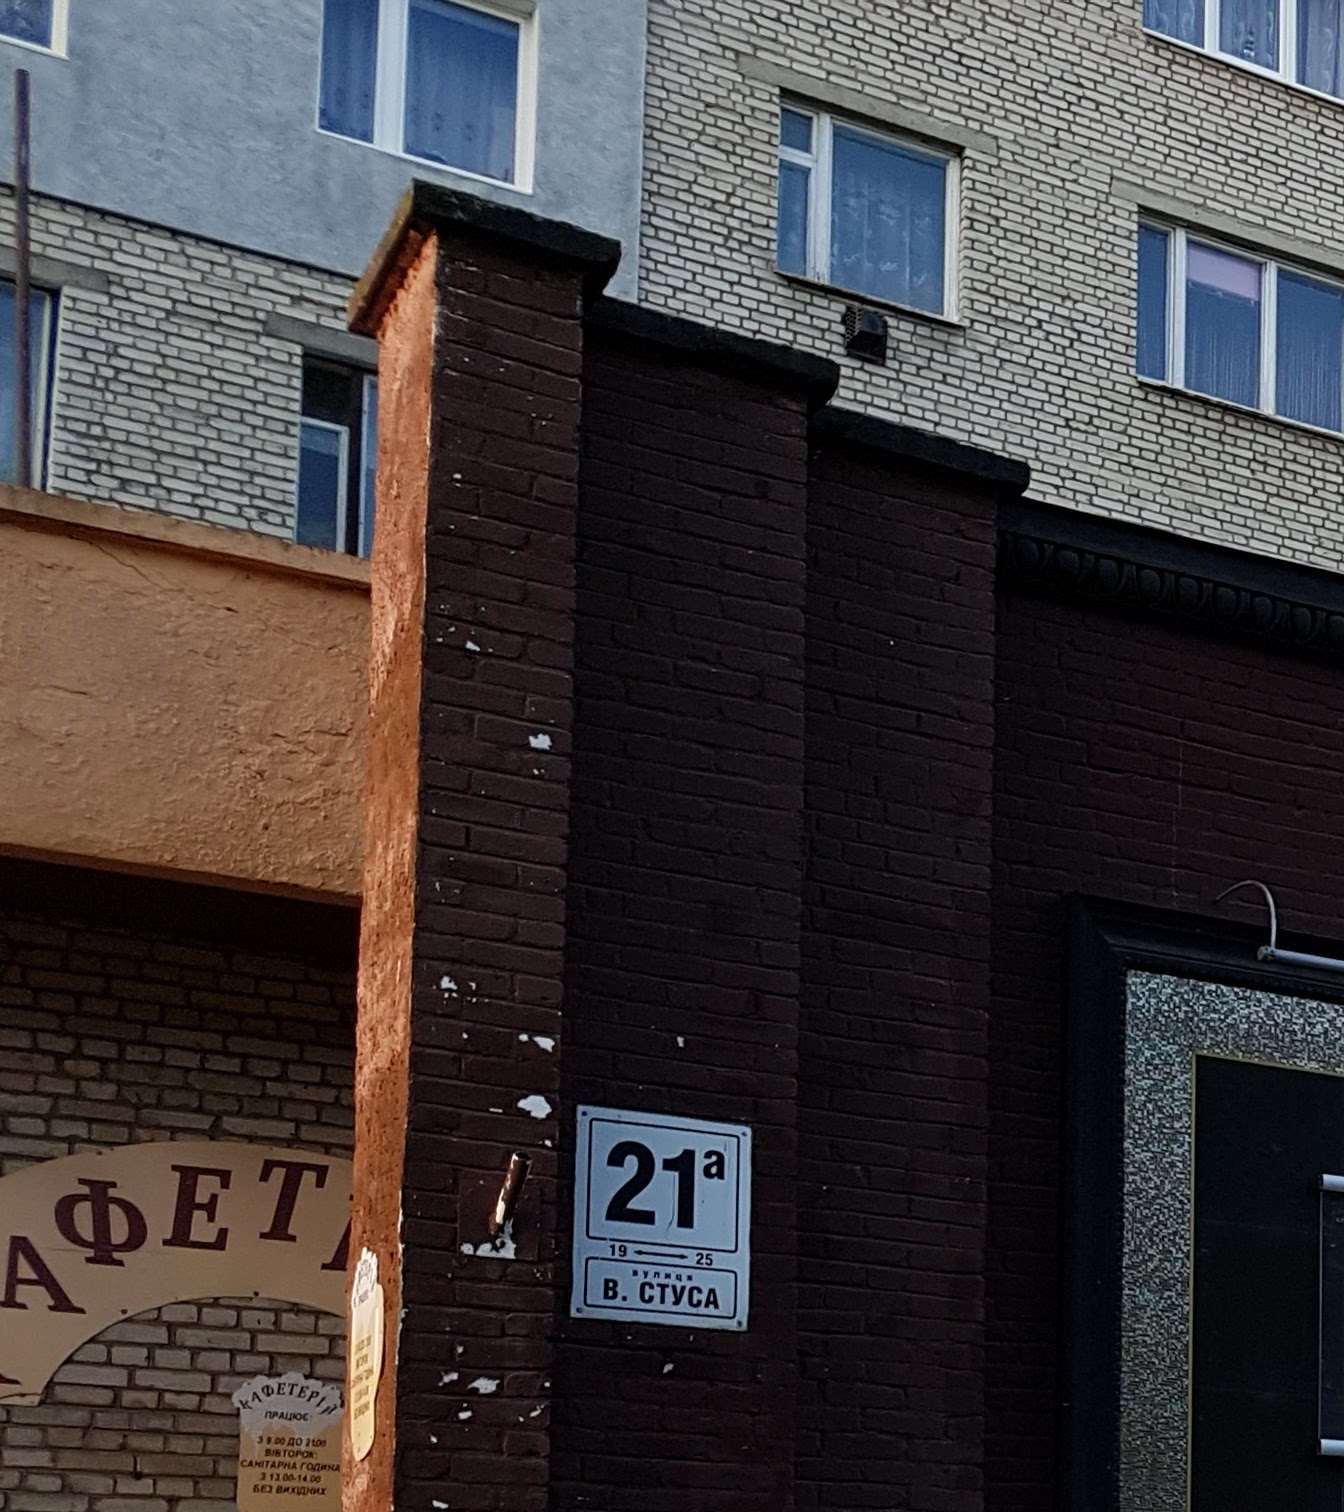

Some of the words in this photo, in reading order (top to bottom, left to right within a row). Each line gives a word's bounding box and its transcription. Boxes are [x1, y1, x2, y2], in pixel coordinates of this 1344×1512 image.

[609, 1244, 627, 1257] 19
[695, 1252, 713, 1266] 25
[0, 1158, 354, 1386] АФЕТ
[632, 1269, 693, 1282] вулиця
[603, 1278, 628, 1302] В.
[639, 1281, 720, 1310] СТУСА
[240, 1460, 298, 1470] САНІТАРНА
[300, 1462, 341, 1473] ГОДИНА
[253, 1484, 273, 1494] БЕЗ
